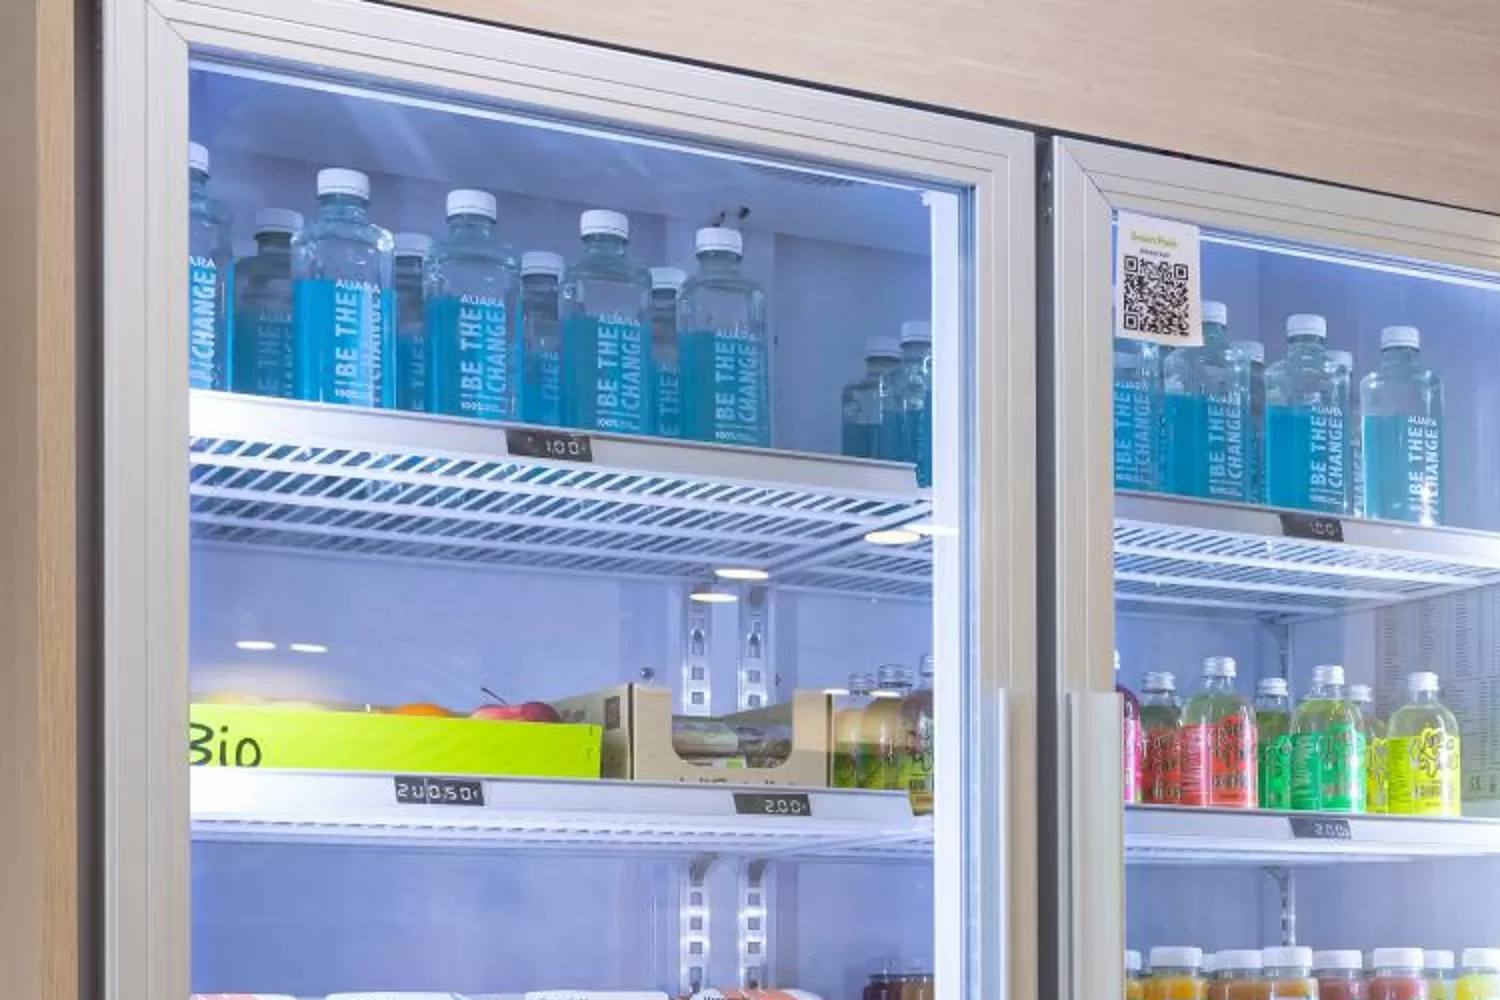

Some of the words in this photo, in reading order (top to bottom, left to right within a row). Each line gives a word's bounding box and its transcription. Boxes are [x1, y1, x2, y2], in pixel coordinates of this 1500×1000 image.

[335, 291, 359, 338] THE
[459, 307, 483, 351] THE
[335, 347, 359, 379] BE
[598, 327, 620, 368] THE
[714, 342, 736, 383] THE
[460, 361, 483, 390] BE
[598, 380, 619, 407] BE
[714, 393, 736, 421] BE
[1311, 416, 1327, 453] THE
[1408, 427, 1424, 463] THE
[1328, 417, 1343, 489] CHANGE
[1311, 460, 1327, 488] BE
